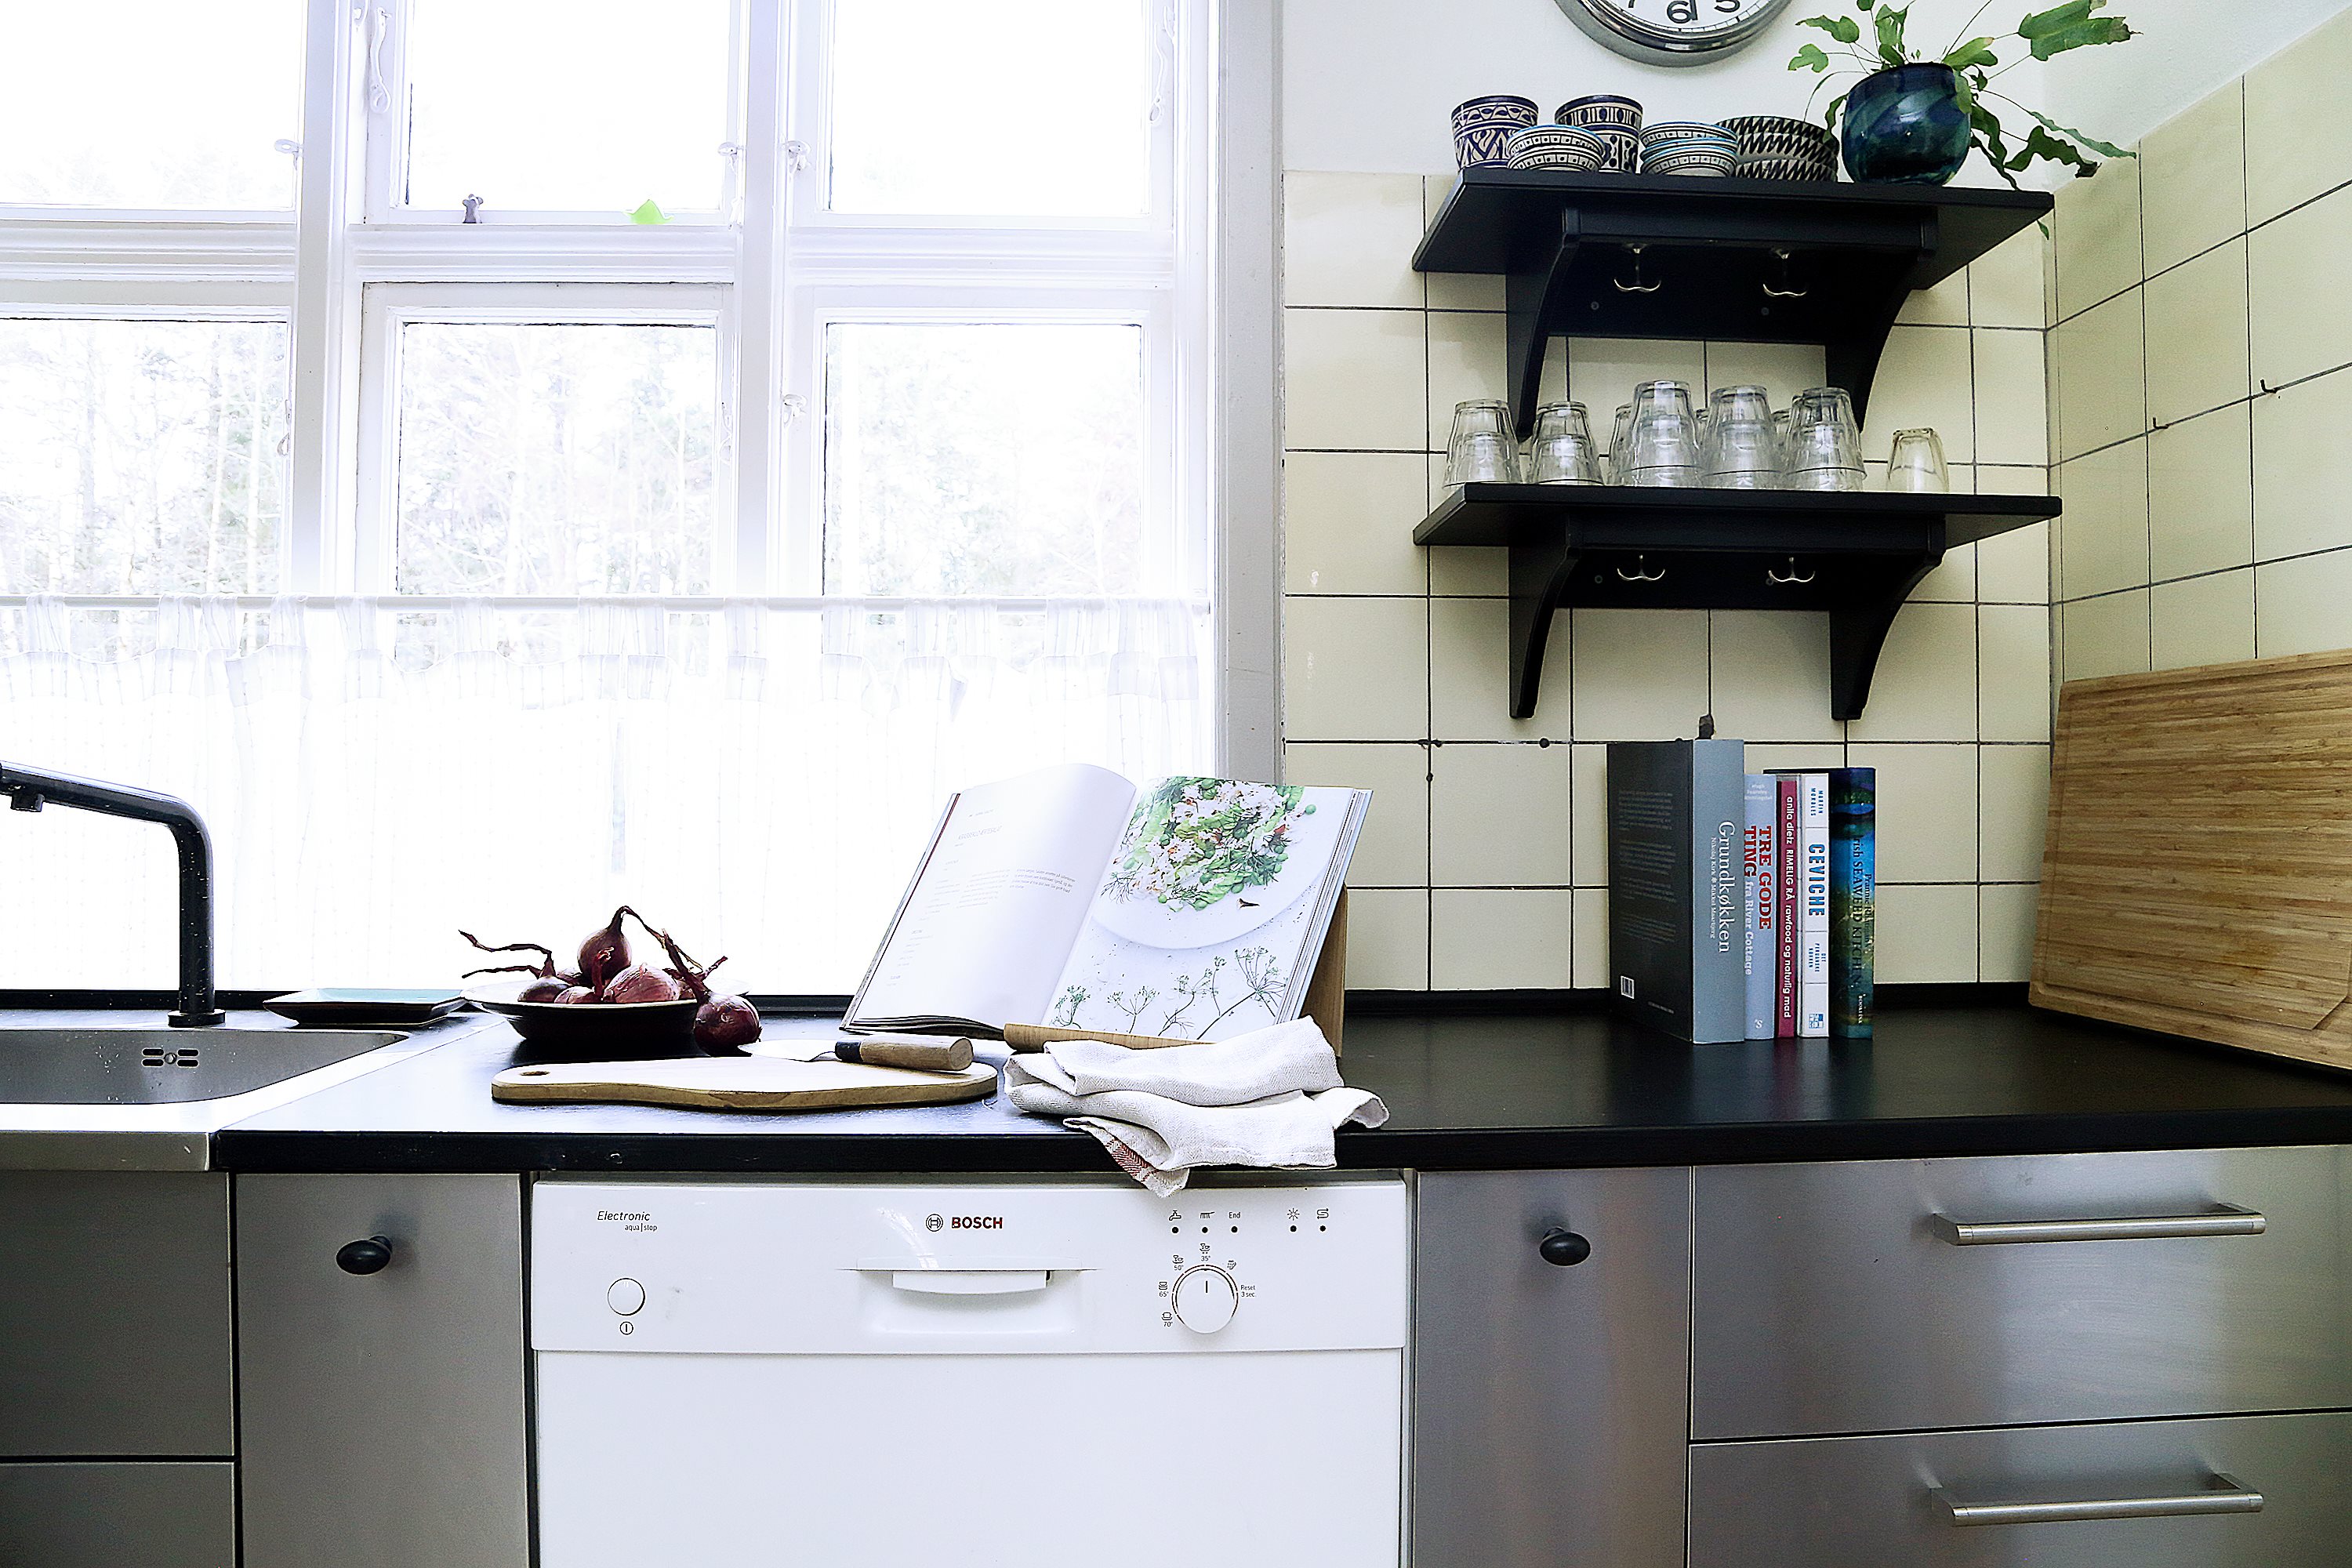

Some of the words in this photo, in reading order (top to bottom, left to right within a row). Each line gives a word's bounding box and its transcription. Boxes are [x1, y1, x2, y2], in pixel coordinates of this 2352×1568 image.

[1786, 796, 1795, 820] anita
[1759, 825, 1772, 866] TRE
[1786, 822, 1795, 844] dietz
[1744, 825, 1757, 877] TING
[1718, 821, 1736, 954] Grundkøkken
[1744, 880, 1755, 898] fra
[1785, 887, 1795, 901] RÅ
[1808, 844, 1825, 916] CEVICHE
[1853, 861, 1864, 923] SEAWEED
[1744, 899, 1754, 929] River
[1759, 872, 1772, 930] GODE
[1784, 905, 1793, 943] rawfood
[1744, 931, 1754, 975] Cottage
[1783, 945, 1791, 958] og
[1782, 960, 1792, 994] naturlig
[597, 1210, 651, 1221] Electronic
[951, 1216, 1004, 1229] BOSCH
